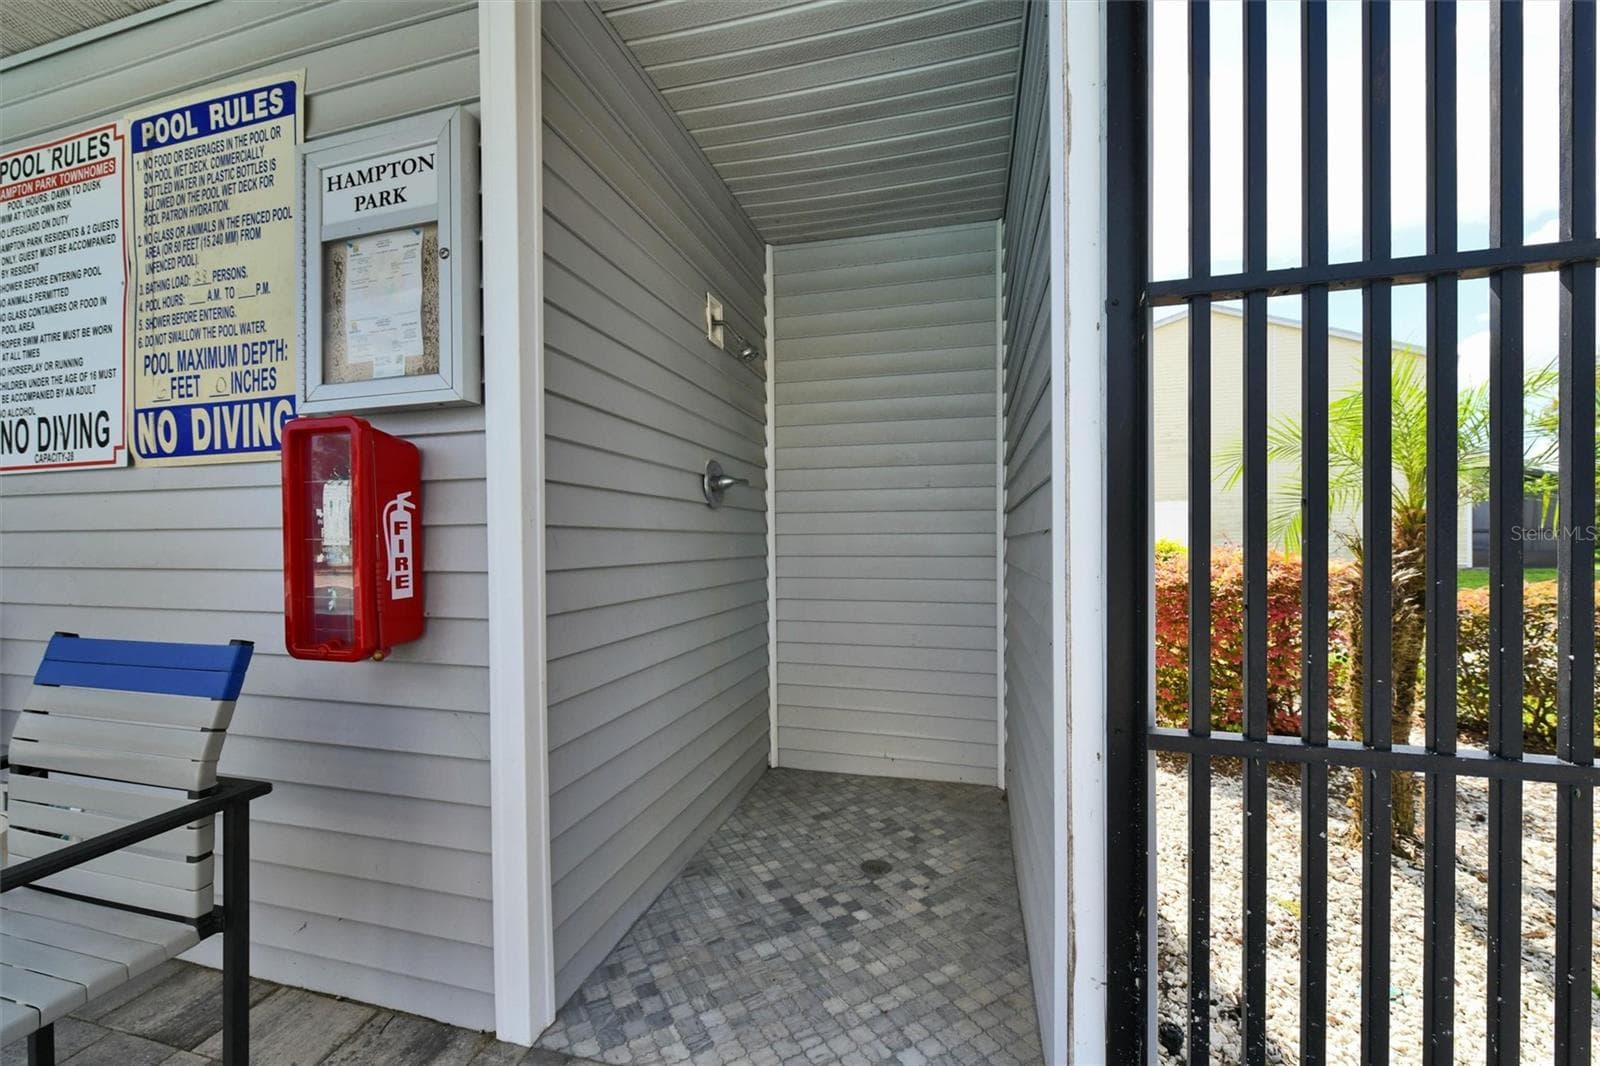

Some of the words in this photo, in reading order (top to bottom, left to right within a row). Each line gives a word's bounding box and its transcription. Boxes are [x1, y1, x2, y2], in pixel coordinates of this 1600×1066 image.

[141, 111, 198, 147] POOL
[209, 87, 284, 130] RULES
[0, 153, 45, 184] POOL
[52, 132, 110, 170] RULES
[143, 155, 152, 170] NO
[154, 153, 172, 167] FOOD
[174, 150, 183, 163] OR
[185, 140, 224, 160] BEVERAGES
[226, 138, 233, 149] IN
[235, 135, 248, 147] THE
[250, 131, 269, 145] POOL
[270, 126, 281, 139] OR
[144, 170, 153, 184] ON
[155, 165, 172, 181] POOL
[174, 162, 188, 177] WET
[211, 147, 264, 169] COMMERCIALLY
[144, 181, 173, 199] BOTTLED
[174, 177, 197, 193] WATER
[199, 176, 205, 187] IN
[206, 168, 235, 184] PLASTIC
[237, 161, 267, 178] BOTTLES
[270, 159, 276, 171] IS
[327, 153, 435, 192] HAMPTON
[0, 184, 33, 199] AMPTON
[35, 176, 57, 190] PARK
[60, 161, 114, 185] TOWNHOMES
[144, 196, 175, 212] ALLOWED
[176, 193, 186, 205] ON
[187, 190, 200, 202] THE
[202, 187, 220, 200] POOL
[222, 183, 236, 196] WET
[238, 179, 257, 193] DECK
[259, 175, 274, 188] FOR
[8, 200, 24, 210] POOL
[51, 188, 70, 200] DAWN
[72, 186, 81, 194] TO
[83, 181, 100, 193] DUSK
[354, 186, 407, 213] PARK
[0, 213, 12, 223] WIM
[14, 211, 21, 220] AT
[23, 206, 39, 218] YOUR
[40, 203, 55, 214] OWN
[56, 199, 72, 211] RISK
[144, 212, 160, 227] POOL
[161, 208, 187, 223] PATRON
[189, 201, 229, 217] HYDRATION.
[0, 240, 25, 252] AMPTON
[27, 236, 42, 247] PARK
[44, 228, 79, 243] RESIDENTS
[81, 226, 85, 236] &
[87, 225, 91, 234] 2
[92, 219, 119, 232] GUESTS
[7, 222, 40, 237] LIFEGUARD
[42, 218, 51, 229] ON
[52, 215, 69, 227] DUTY
[144, 232, 153, 246] NO
[154, 226, 174, 243] GLASS
[175, 224, 185, 237] OR
[186, 219, 216, 236] ANIMALS
[217, 218, 225, 230] IN
[227, 216, 240, 229] THE
[242, 210, 270, 226] FENCED
[272, 207, 292, 221] POOL
[19, 250, 38, 262] GUEST
[40, 246, 57, 257] MUST
[58, 244, 67, 254] BE
[69, 234, 116, 251] ACCOMPANIED
[145, 244, 160, 259] AREA
[162, 242, 173, 257] (OR
[174, 240, 181, 255] 50
[182, 238, 199, 251] FEET
[201, 235, 211, 250] (15
[212, 234, 223, 246] 240
[225, 231, 238, 245] MM)
[240, 226, 261, 241] FROM
[0, 280, 23, 293] HOWER
[24, 275, 48, 289] BEFORE
[50, 269, 81, 284] ENTERING
[83, 266, 102, 277] POOL
[1, 269, 9, 279] BY
[10, 262, 39, 277] RESIDENT
[145, 257, 176, 275] UNFENCED
[145, 278, 170, 295] BATHING
[171, 275, 190, 289] LOAD:
[212, 266, 248, 282] PERSONS.
[8, 293, 33, 306] ANIMALS
[35, 287, 69, 301] PERMITTED
[8, 309, 27, 321] GLASS
[28, 303, 67, 317] CONTAINERS
[68, 300, 78, 311] OR
[80, 297, 98, 309] FOOD
[100, 296, 107, 305] IN
[145, 298, 161, 311] POOL
[225, 287, 235, 300] TO
[256, 282, 270, 295] P.M.
[2, 325, 17, 335] POOL
[19, 321, 35, 332] AREA
[145, 314, 171, 329] SHOWER
[172, 311, 197, 325] BEFORE
[199, 306, 237, 321] ENTERING.
[0, 338, 21, 349] ROPER
[23, 336, 38, 346] SWIM
[40, 332, 60, 344] ATTIRE
[63, 329, 80, 340] MUST
[82, 327, 90, 337] BE
[92, 324, 112, 336] WORN
[145, 334, 155, 347] DO
[155, 332, 167, 345] NOT
[169, 327, 201, 343] SWALLOW
[203, 326, 217, 339] THE
[218, 324, 238, 336] POOL
[240, 321, 267, 334] WATER.
[2, 352, 9, 360] AT
[10, 351, 21, 360] ALL
[22, 348, 40, 358] TIMES
[8, 362, 42, 375] HORSEPLAY
[44, 361, 54, 371] OR
[55, 357, 83, 369] RUNNING
[144, 352, 173, 376] POOL
[177, 343, 238, 372] MAXIMUM
[242, 338, 288, 366] DEPTH:
[0, 380, 27, 391] HILDREN
[29, 377, 49, 388] UNDER
[51, 375, 63, 385] THE
[64, 373, 77, 383] AGE
[79, 372, 88, 381] OF
[98, 368, 116, 379] MUST
[171, 375, 200, 399] FEET
[231, 367, 276, 394] INCHES
[2, 394, 9, 404] BE
[11, 389, 54, 402] ACCOMPANIED
[56, 388, 63, 398] BY
[65, 388, 74, 397] AN
[76, 385, 96, 396] ADULT
[8, 407, 36, 417] ALCOHOL
[1, 419, 29, 454] NO
[38, 410, 109, 452] DIVING
[138, 409, 177, 454] NO
[394, 521, 409, 589] FIRE
